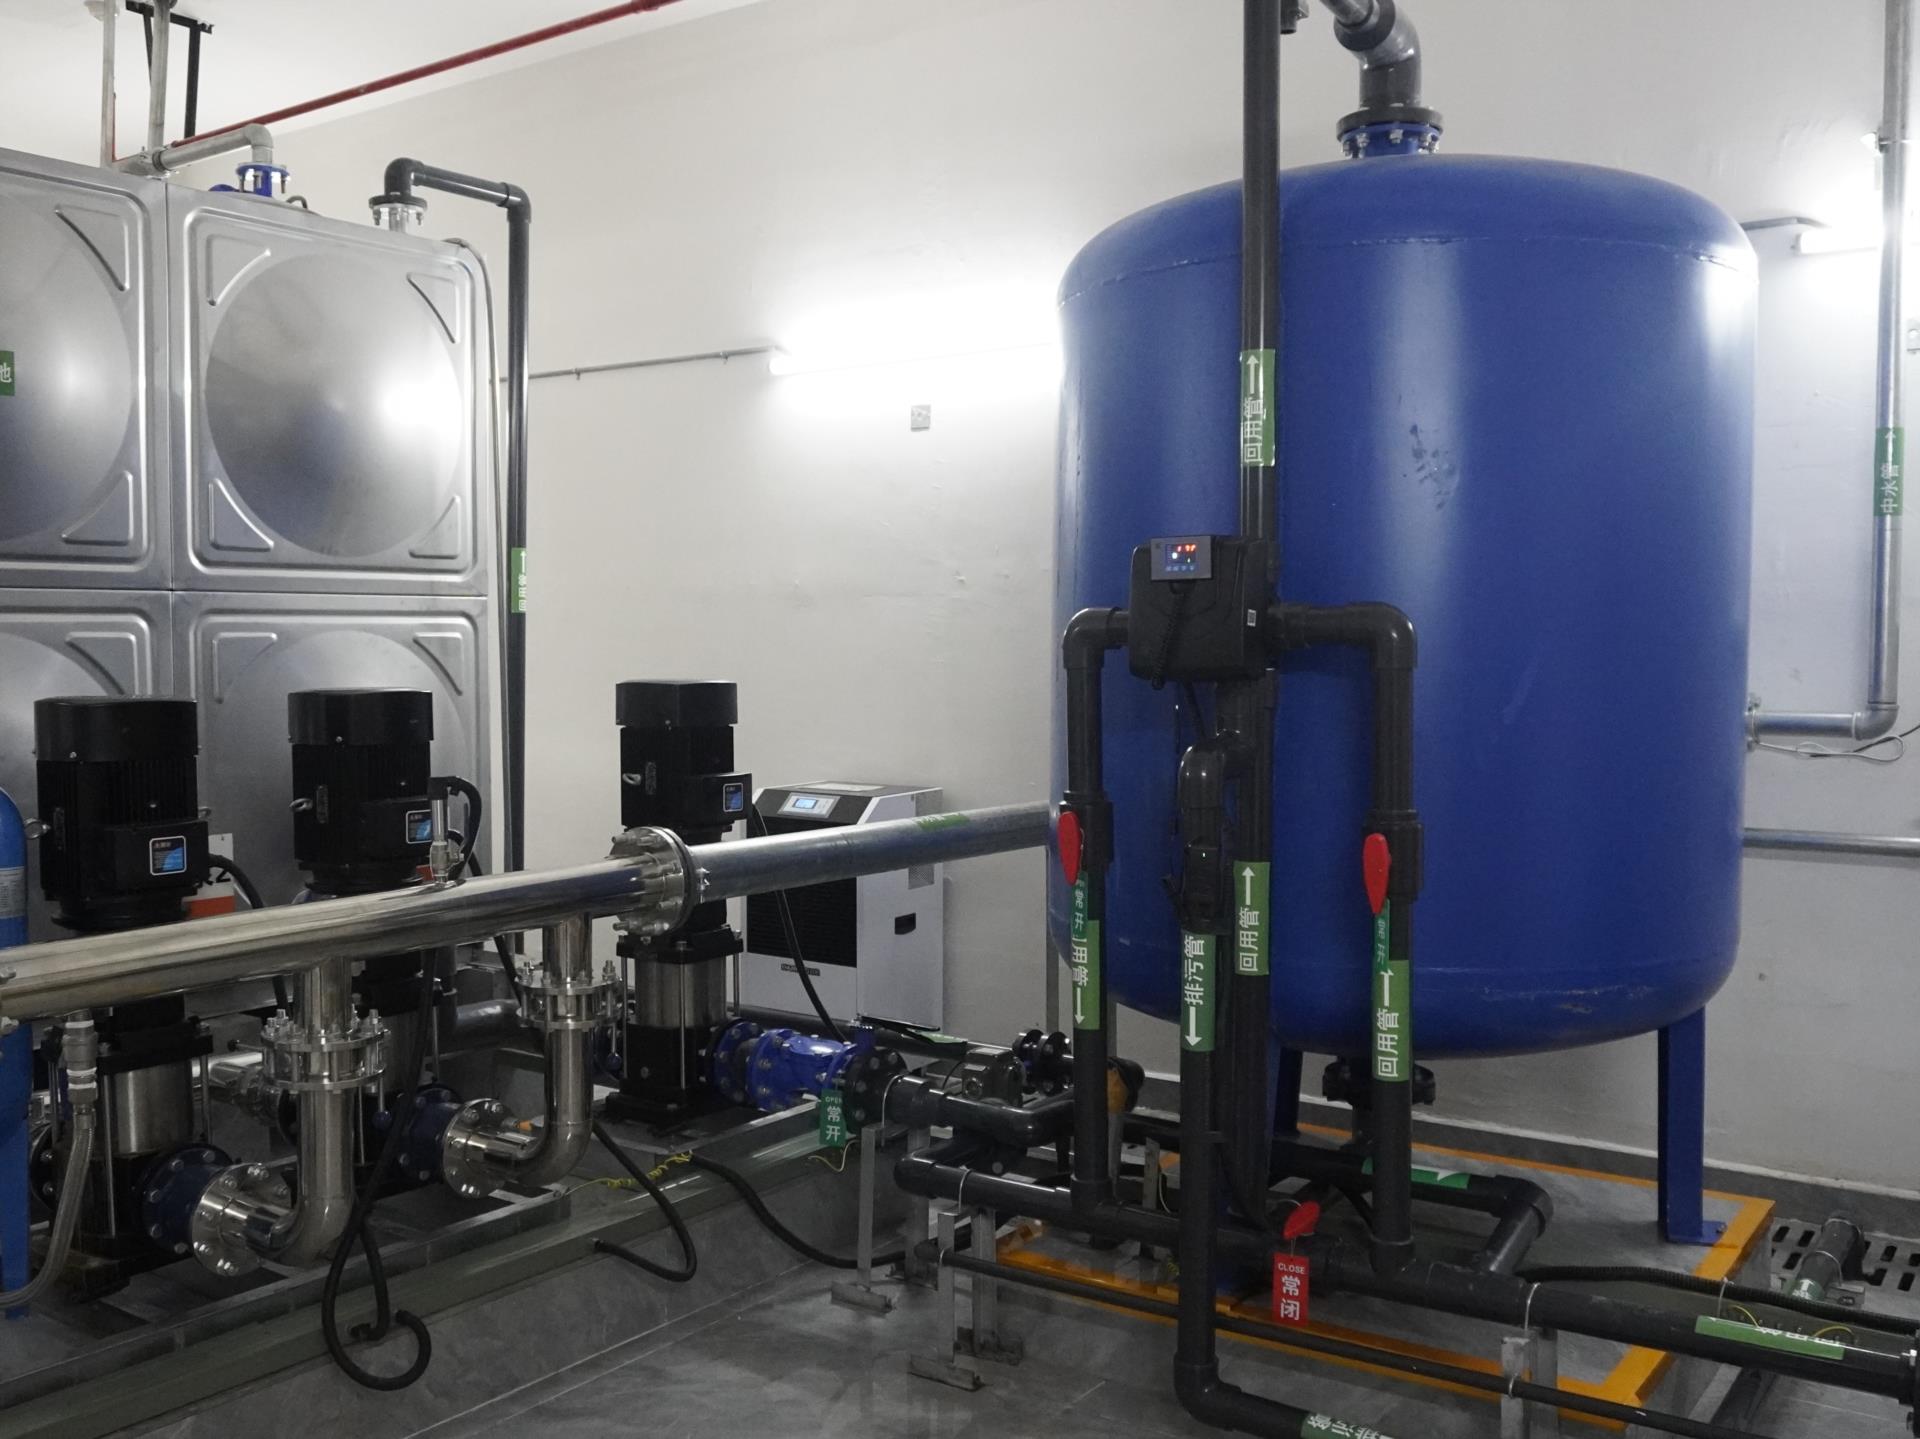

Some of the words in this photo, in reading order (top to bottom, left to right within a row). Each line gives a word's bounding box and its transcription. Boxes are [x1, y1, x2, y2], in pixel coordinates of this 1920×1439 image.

[1243, 397, 1263, 462] 回用管
[1880, 463, 1899, 513] 中水管
[1239, 906, 1260, 972] 回用管
[1184, 934, 1206, 1006] 排污管
[1376, 1007, 1400, 1078] 回用管
[826, 1105, 842, 1142] 常开
[1278, 1262, 1306, 1275] CLOSE
[1280, 1275, 1301, 1321] 常闭
